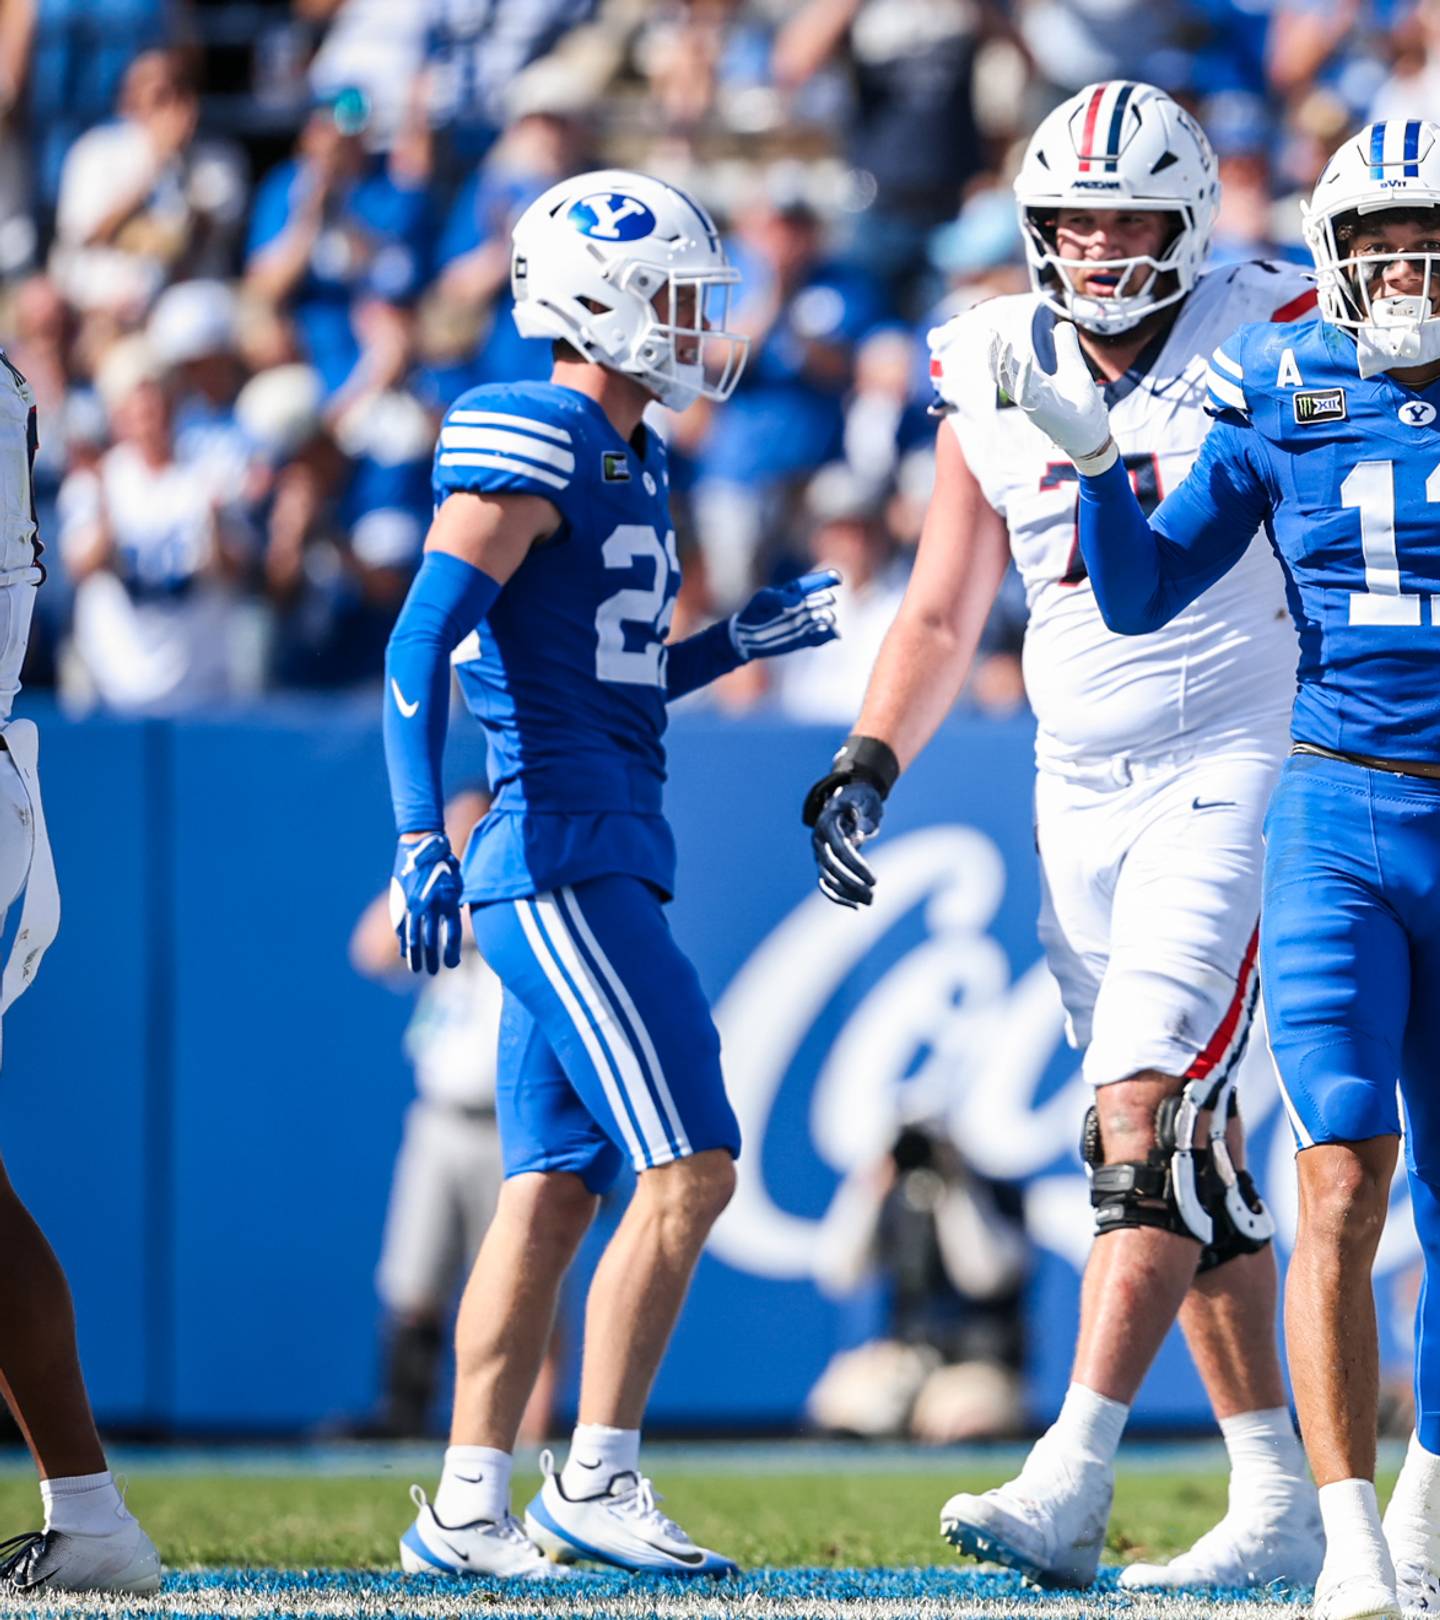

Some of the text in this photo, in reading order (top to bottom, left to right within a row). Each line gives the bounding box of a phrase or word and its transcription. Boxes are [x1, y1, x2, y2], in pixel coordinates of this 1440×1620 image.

[581, 194, 646, 238] Y
[1276, 348, 1303, 388] A
[1406, 405, 1429, 422] Y
[595, 524, 681, 689] 2
